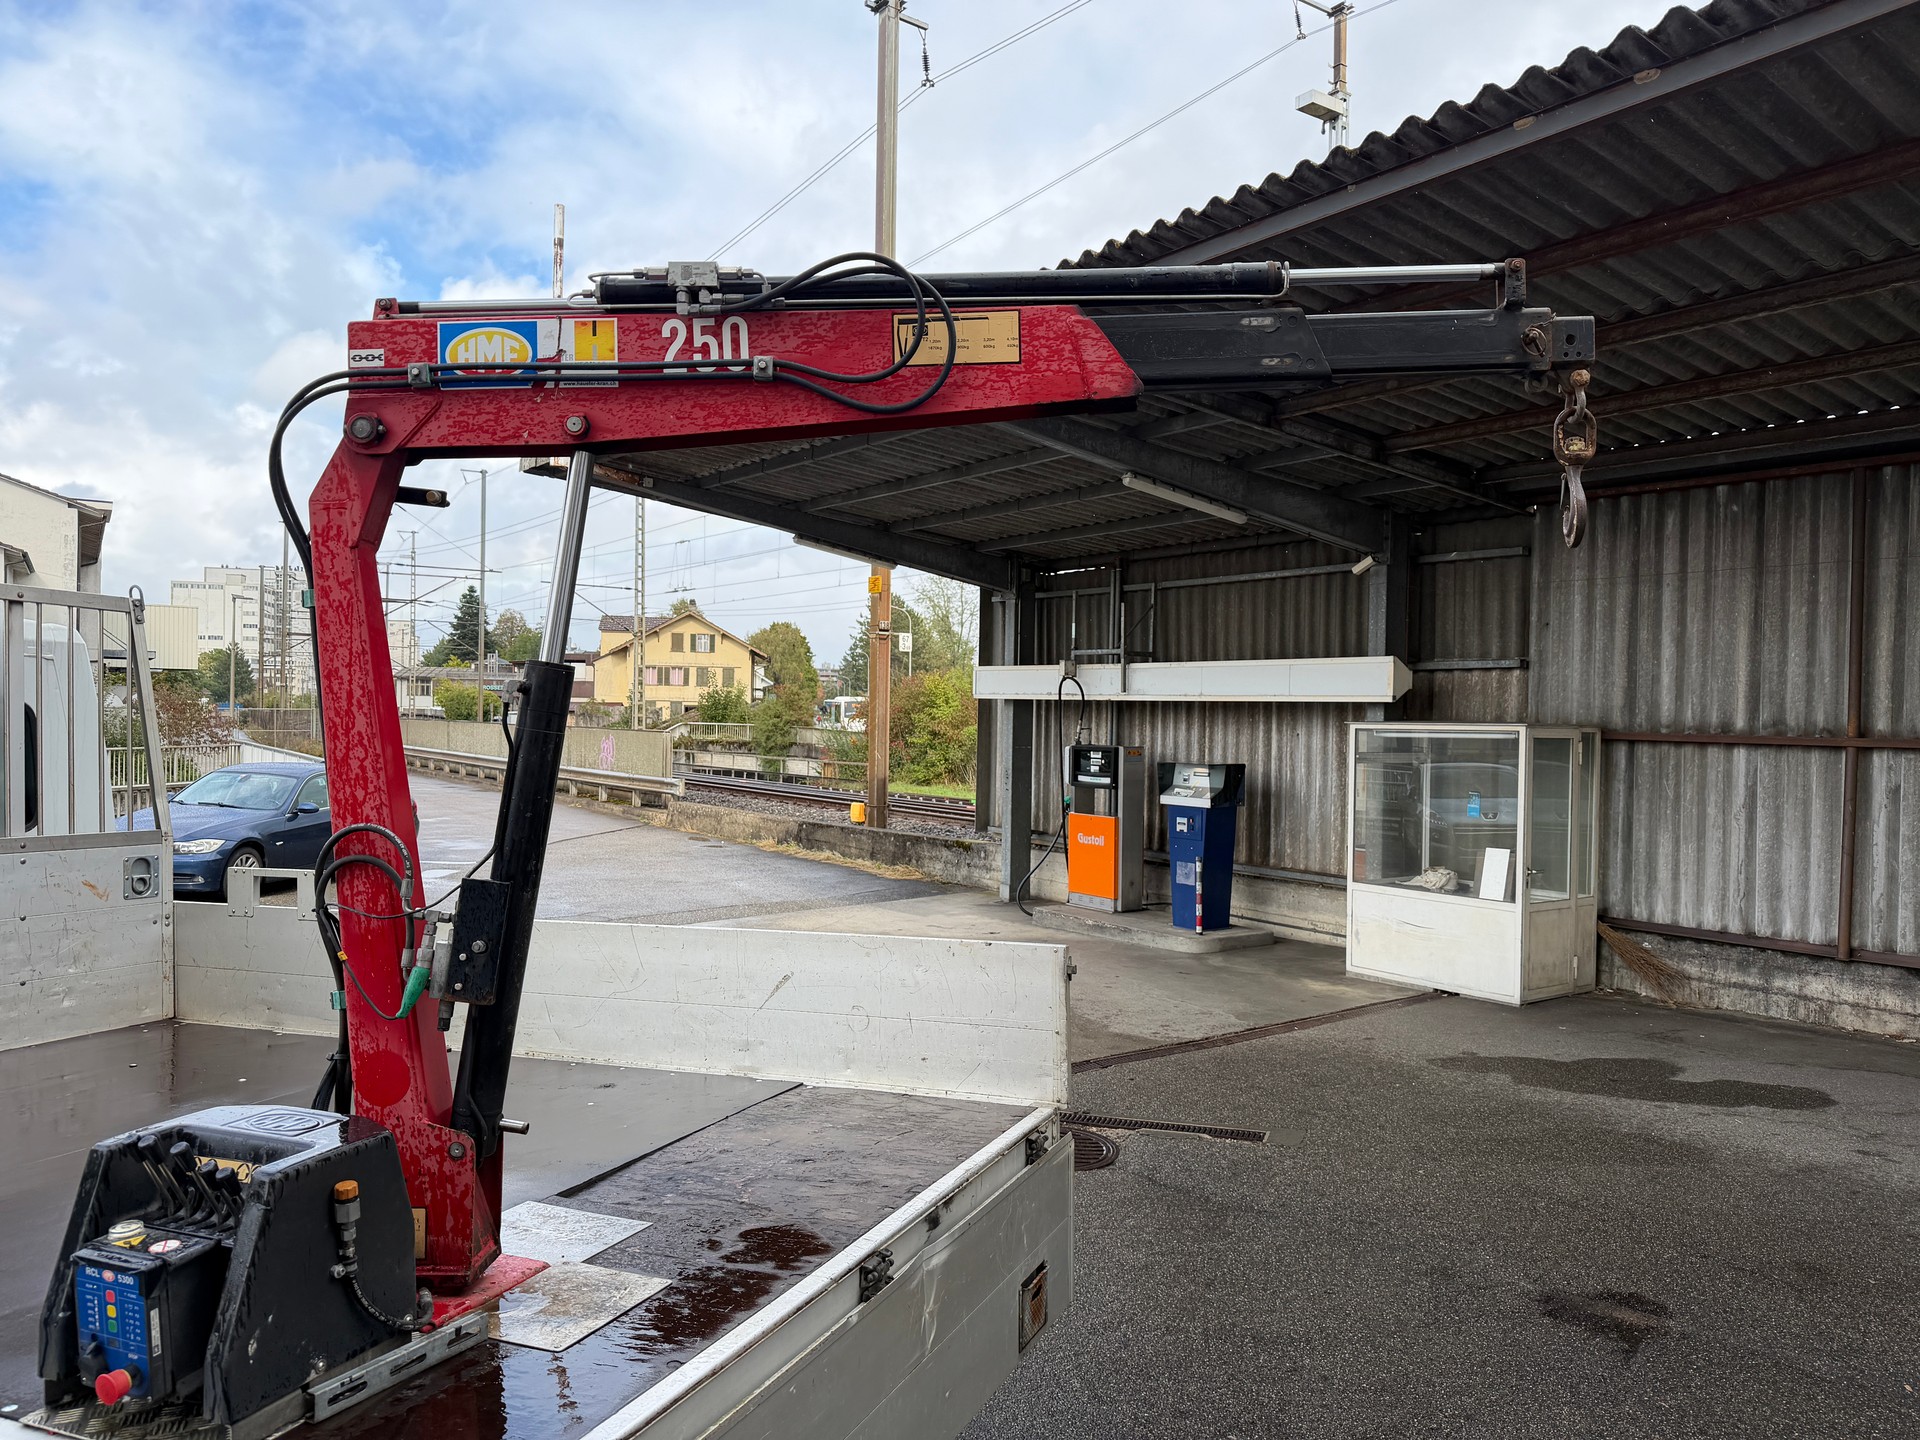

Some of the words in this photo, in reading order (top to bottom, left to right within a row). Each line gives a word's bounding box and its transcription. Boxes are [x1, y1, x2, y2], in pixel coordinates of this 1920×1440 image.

[457, 334, 521, 373] HMF
[661, 315, 750, 373] 250
[85, 1266, 101, 1278] RCL
[117, 1274, 134, 1285] 5300
